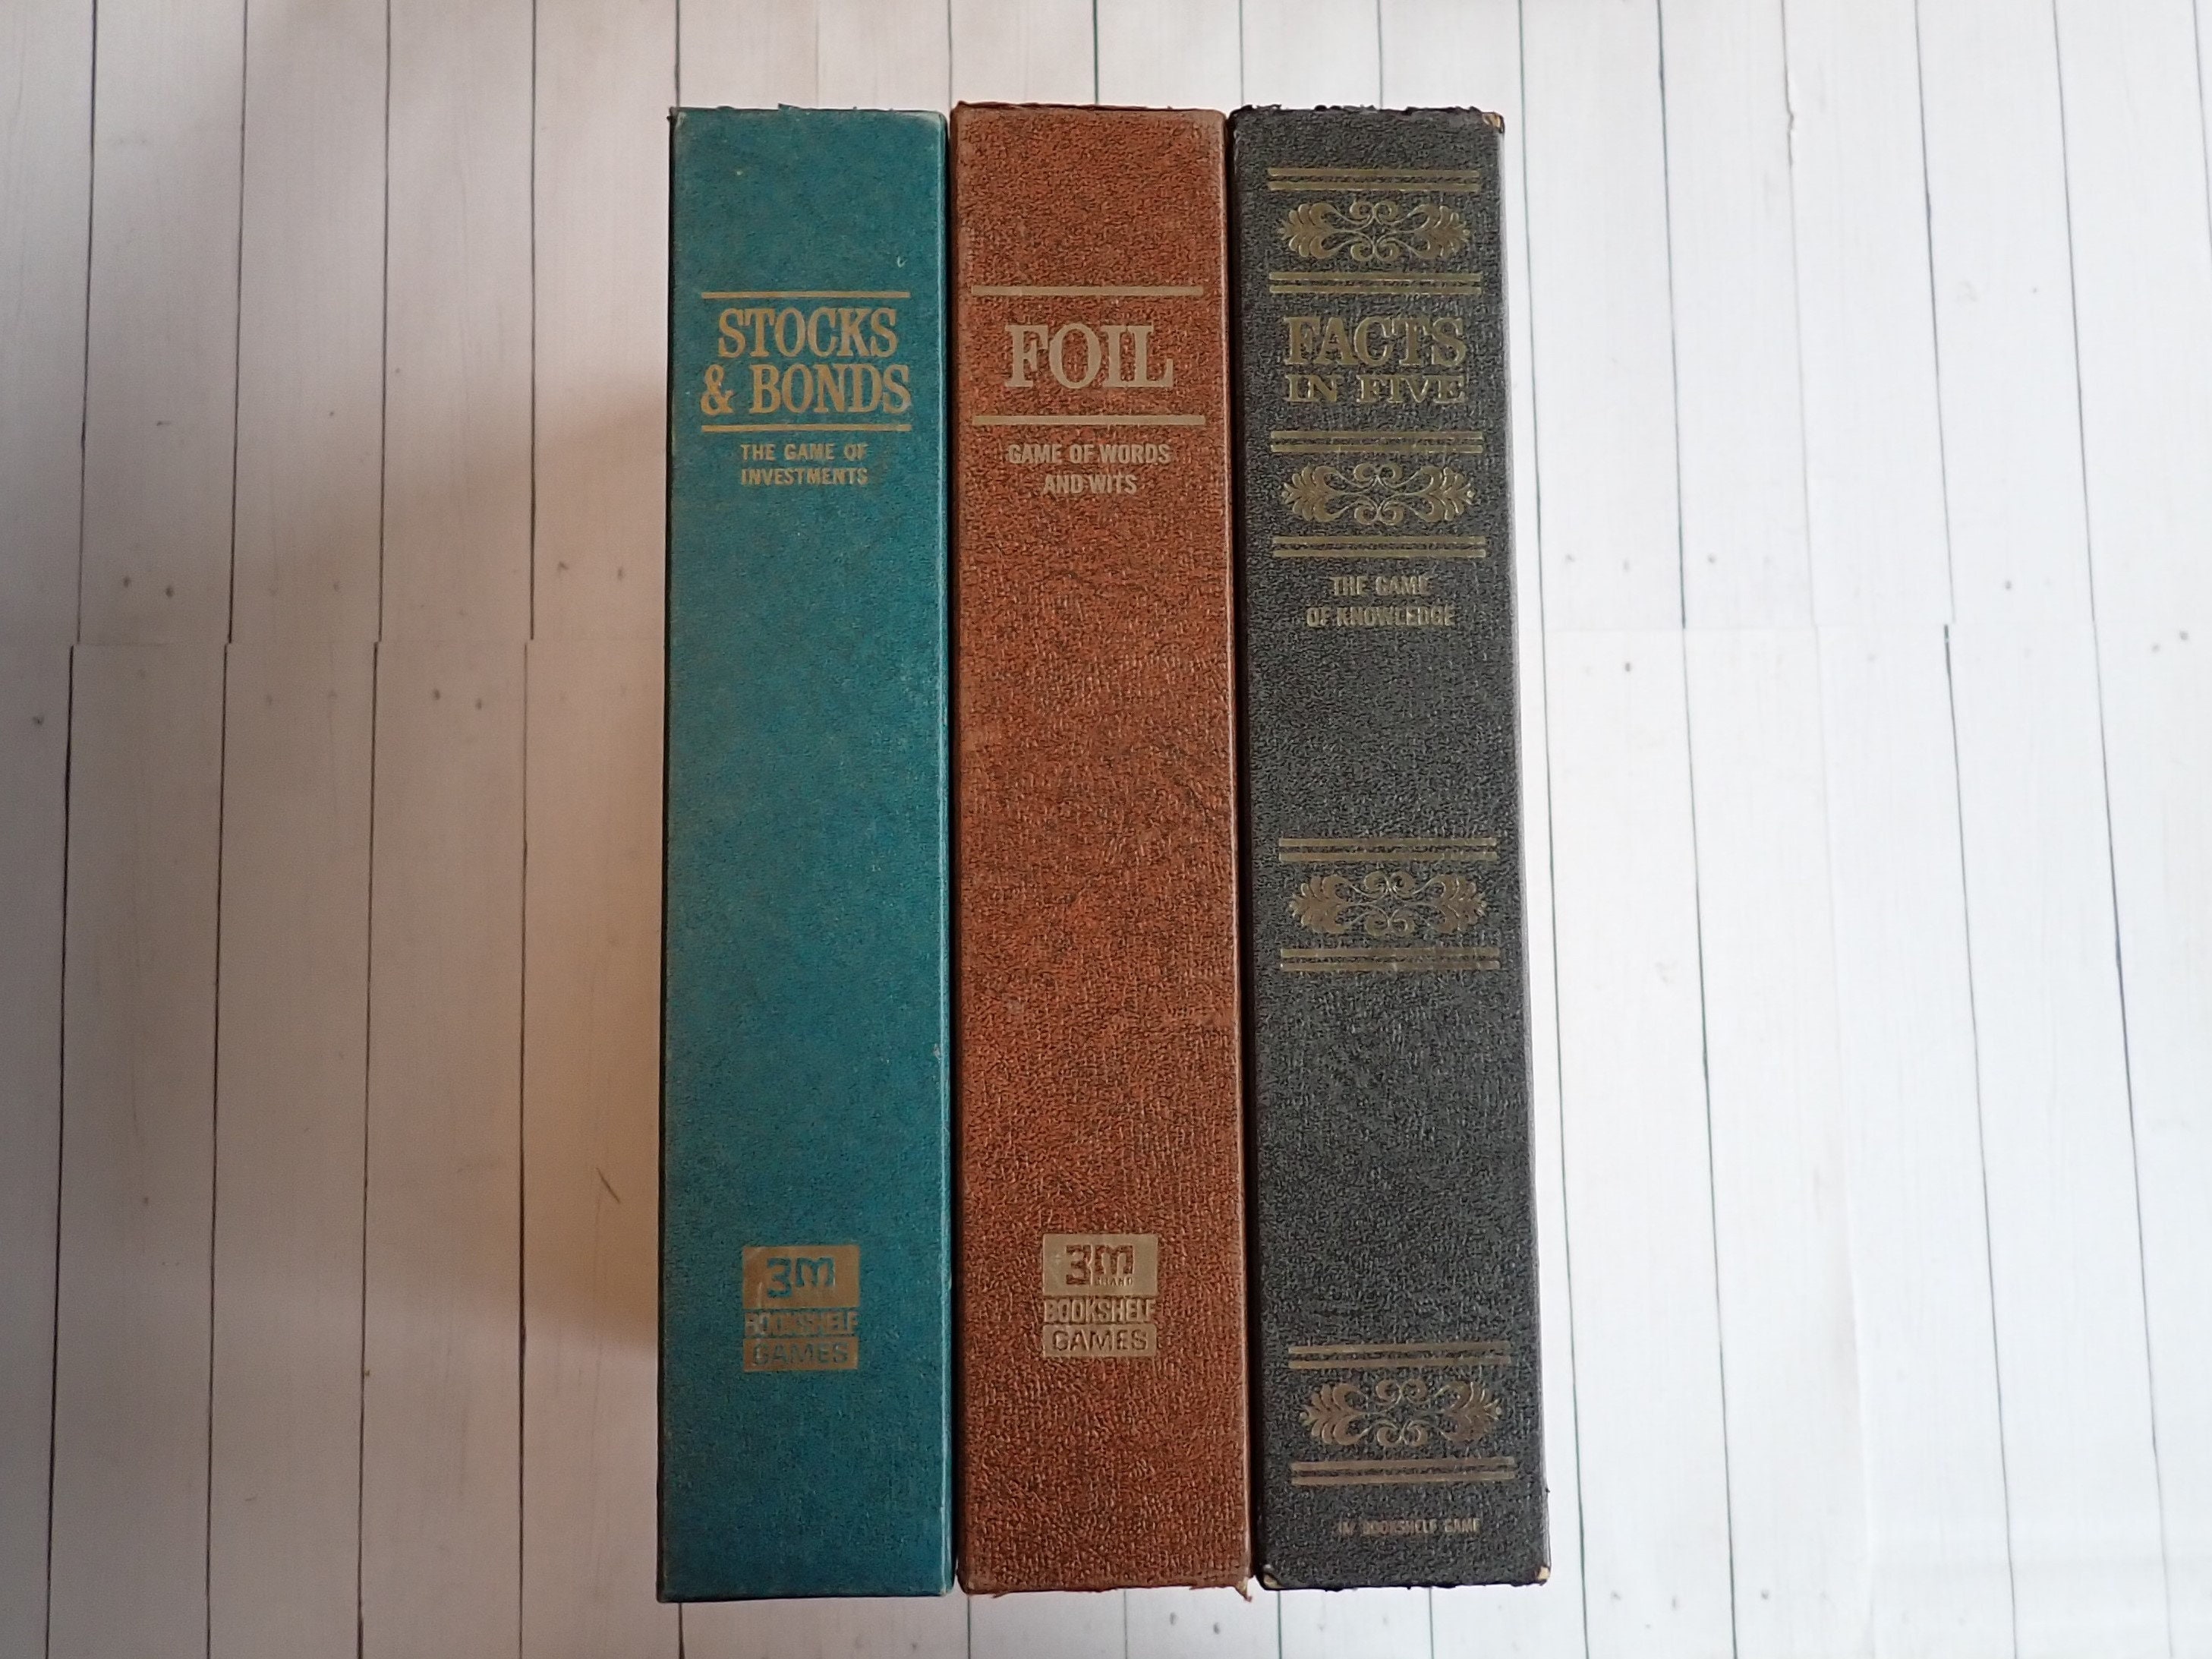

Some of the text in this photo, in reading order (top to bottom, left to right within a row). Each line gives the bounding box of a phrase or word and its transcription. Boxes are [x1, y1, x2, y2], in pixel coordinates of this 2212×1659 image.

[717, 307, 898, 358] STOCKS
[1284, 316, 1467, 367] FACTS
[1004, 323, 1174, 389] FOIL
[700, 363, 911, 415] & BONDS
[1284, 374, 1465, 404] IN FIVE
[740, 442, 868, 461] THE GAME OF
[1007, 443, 1172, 465] GAME OF WORDS
[740, 467, 869, 486] INVESTMENTS
[1042, 473, 1139, 494] AND WITS
[1328, 575, 1432, 597] THE GAME
[1306, 604, 1457, 628] OF KNOWLEDGE
[1063, 1244, 1134, 1285] 3M
[766, 1257, 834, 1299] 3M
[1044, 1298, 1156, 1323] BOOKSHELF
[744, 1310, 860, 1337] BOOKSHELF
[1052, 1329, 1147, 1351] GAMES
[752, 1342, 849, 1366] GAMES
